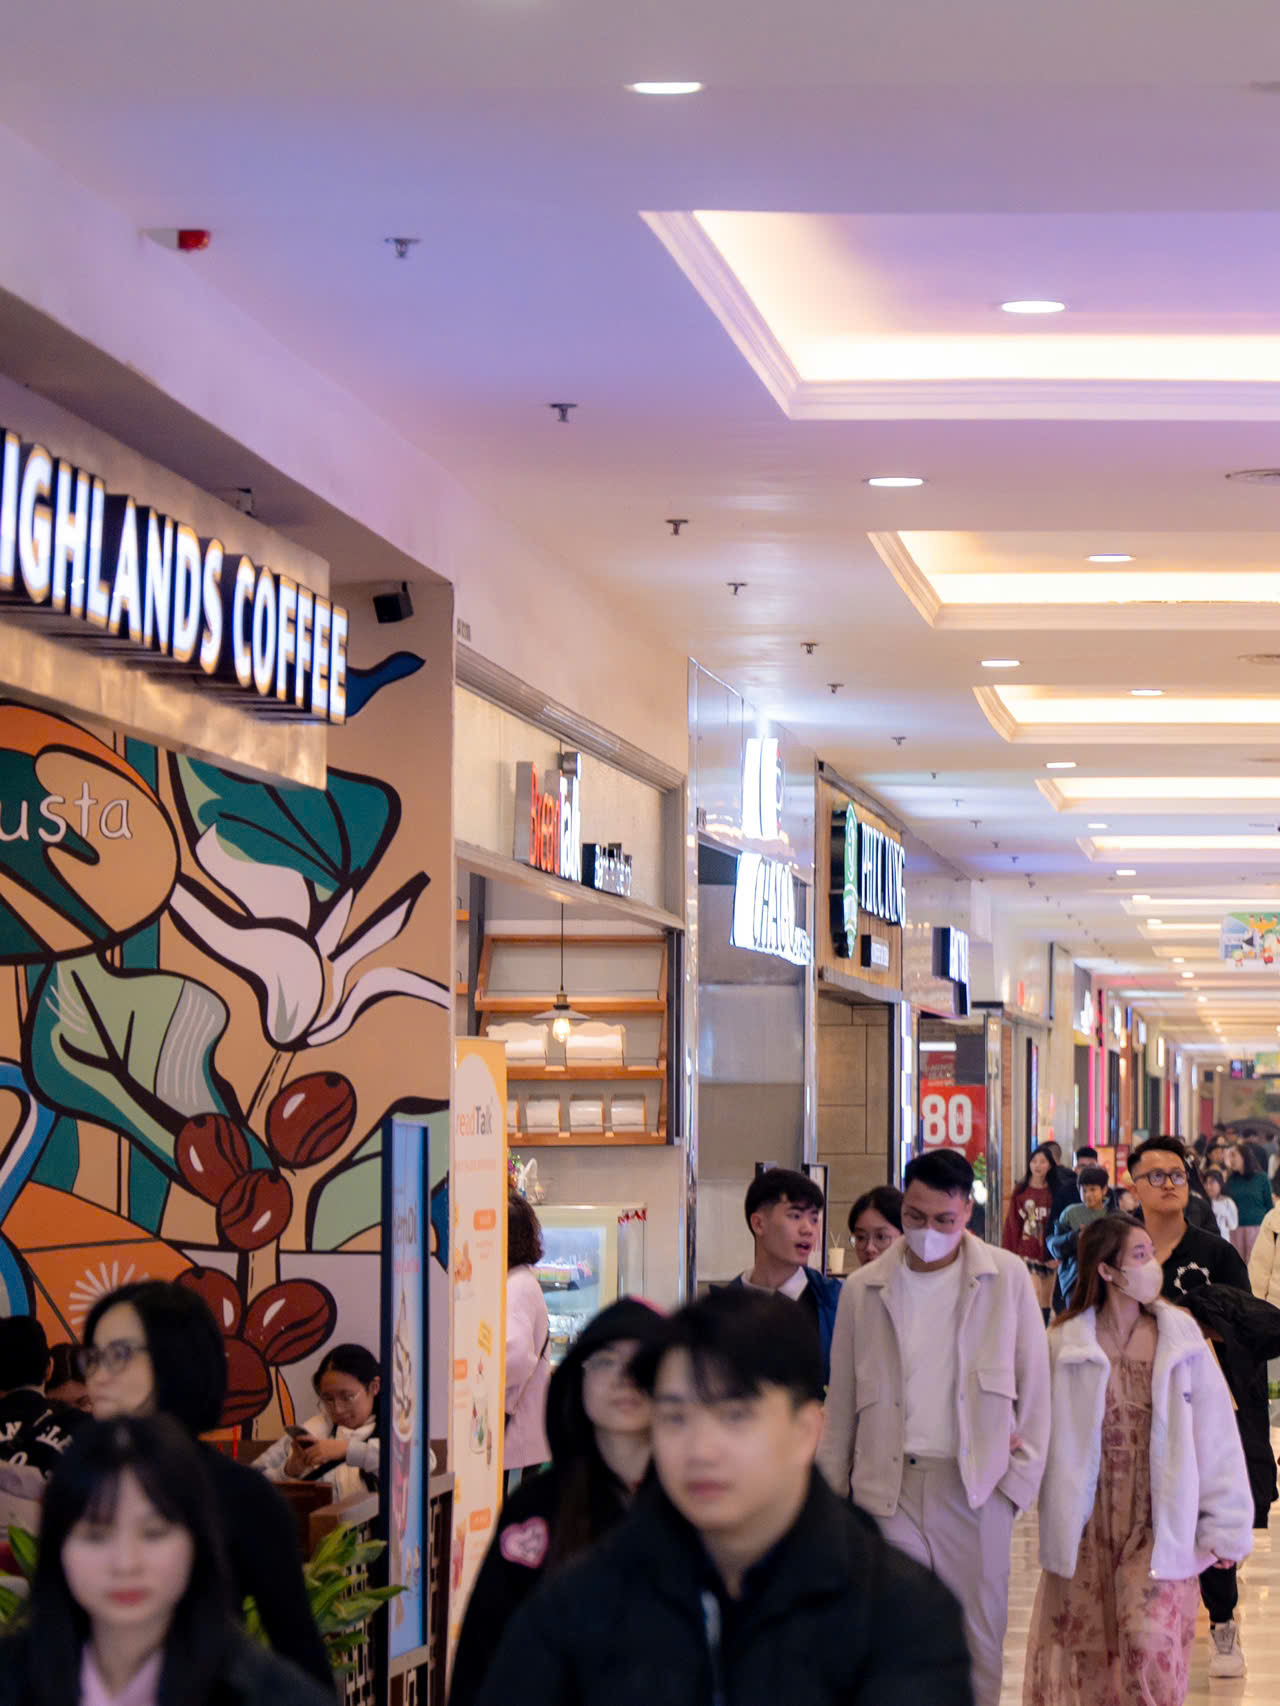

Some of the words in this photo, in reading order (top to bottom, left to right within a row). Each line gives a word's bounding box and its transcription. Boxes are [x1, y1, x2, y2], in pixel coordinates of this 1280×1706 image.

[233, 554, 349, 725] COFFEE
[0, 781, 134, 843] usta
[921, 1093, 973, 1144] 80
